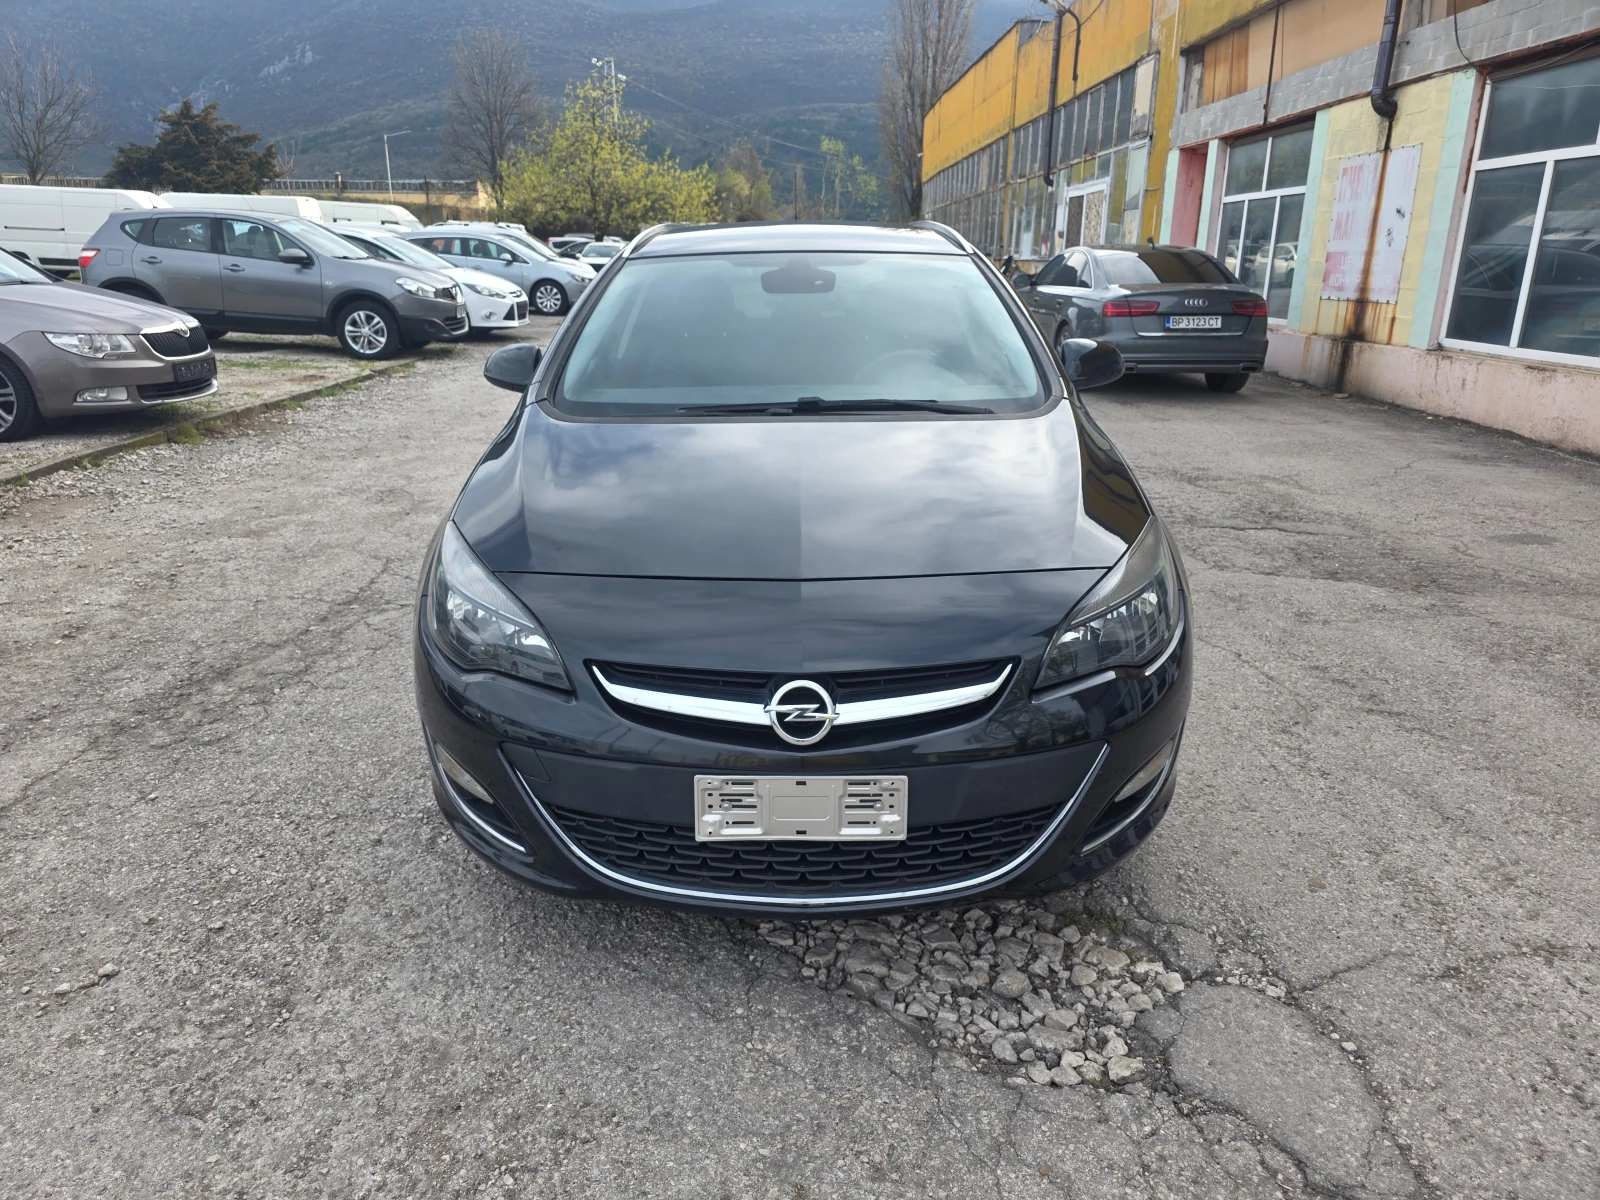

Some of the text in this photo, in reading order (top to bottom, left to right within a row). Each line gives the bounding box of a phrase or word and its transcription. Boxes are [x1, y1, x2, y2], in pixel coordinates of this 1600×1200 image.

[1171, 316, 1220, 327] BP 3123 CT
